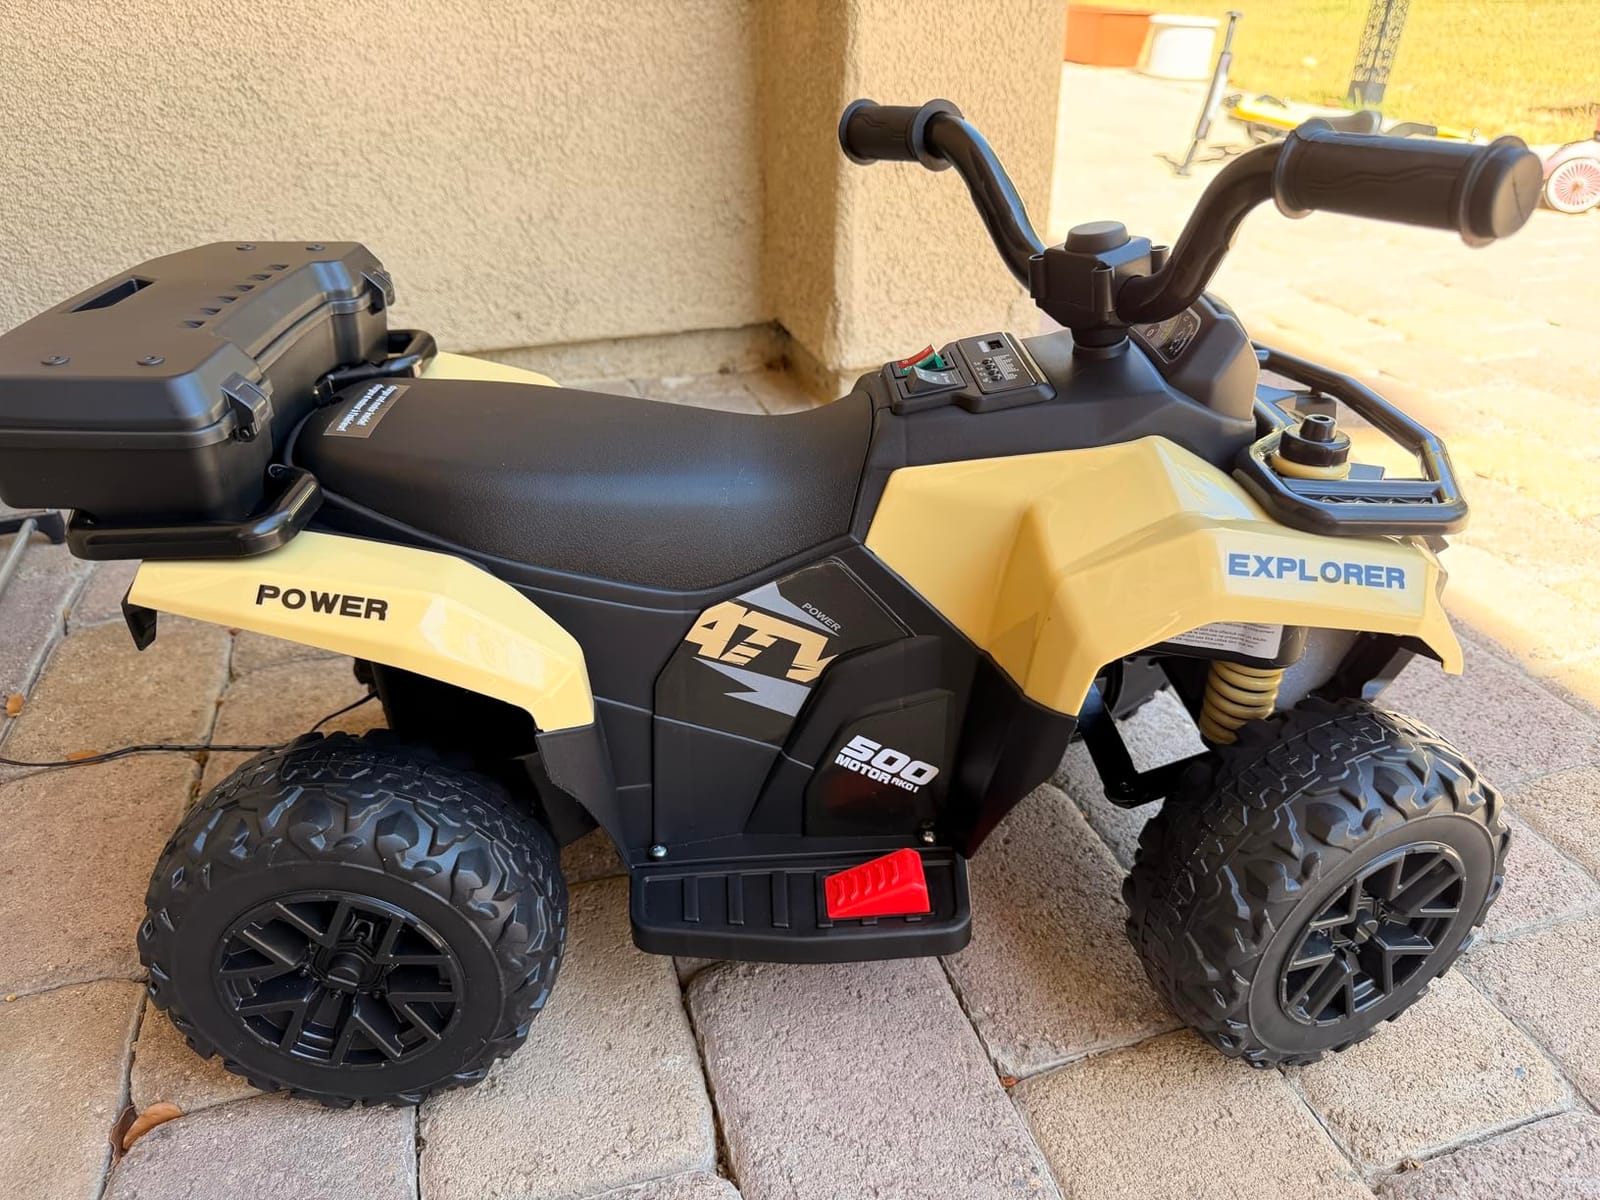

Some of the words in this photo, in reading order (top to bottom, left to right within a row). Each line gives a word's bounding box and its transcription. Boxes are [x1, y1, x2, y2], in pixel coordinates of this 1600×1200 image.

[1228, 552, 1406, 590] EXPLORER
[255, 583, 389, 621] POWER
[801, 602, 842, 632] POWER
[834, 753, 892, 785] MOTOR
[840, 734, 940, 786] 500
